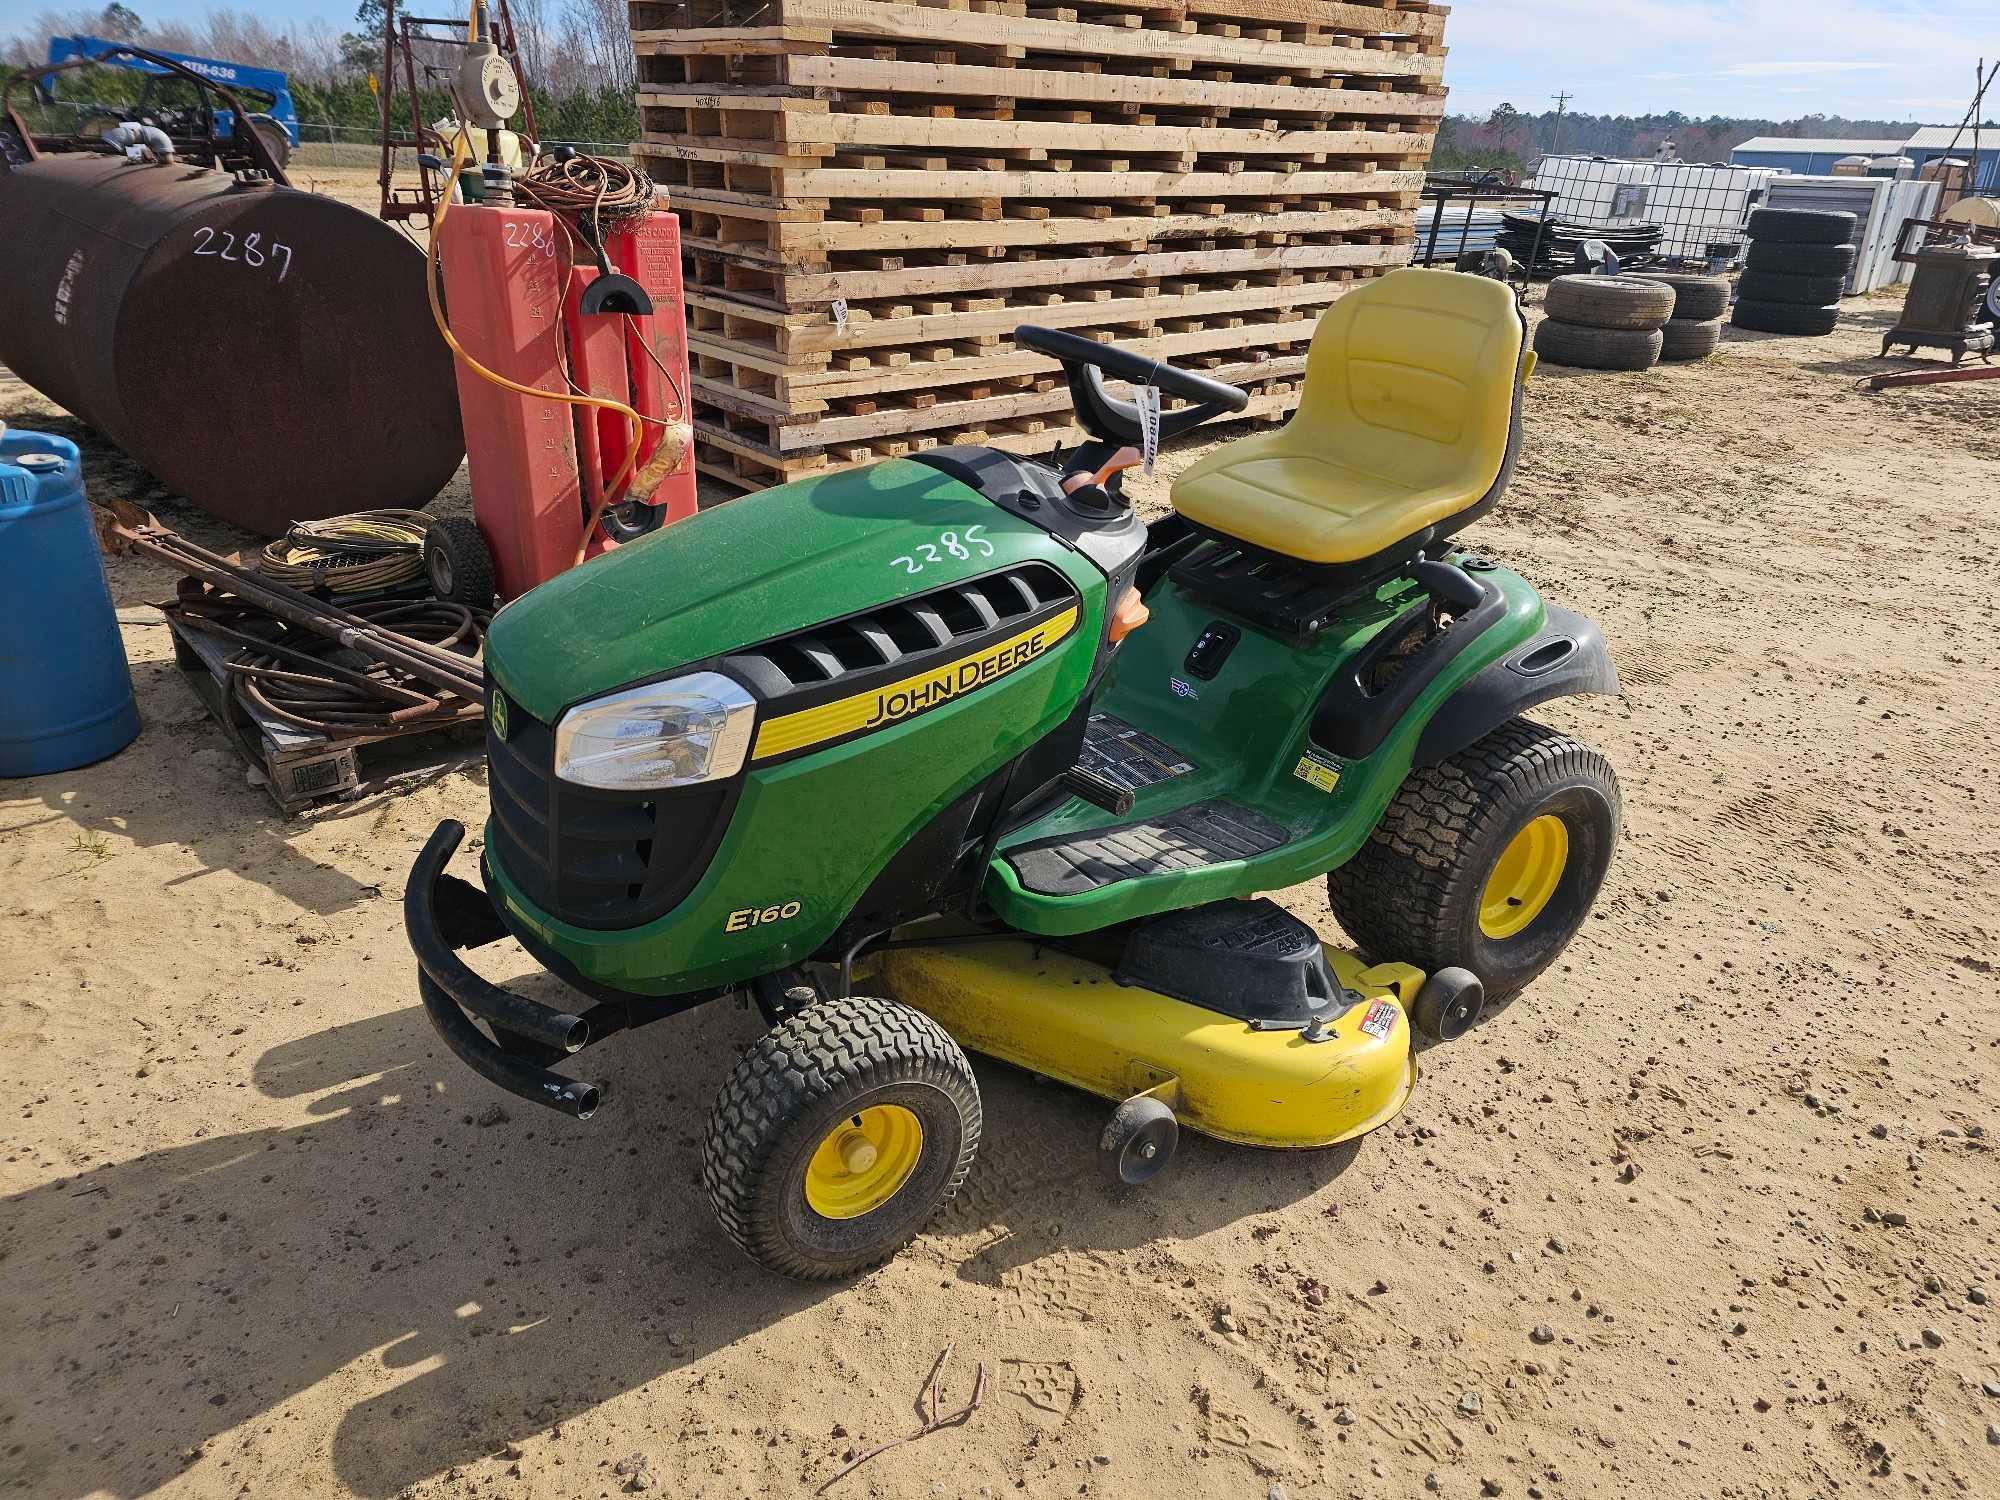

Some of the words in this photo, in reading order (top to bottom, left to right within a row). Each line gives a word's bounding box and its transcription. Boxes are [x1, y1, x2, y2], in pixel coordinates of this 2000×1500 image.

[194, 226, 291, 283] 2287
[504, 222, 555, 257] 2286
[889, 524, 994, 574] 2285
[866, 675, 952, 727] JOHN
[958, 630, 1046, 691] DEERE
[724, 901, 801, 934] E160
